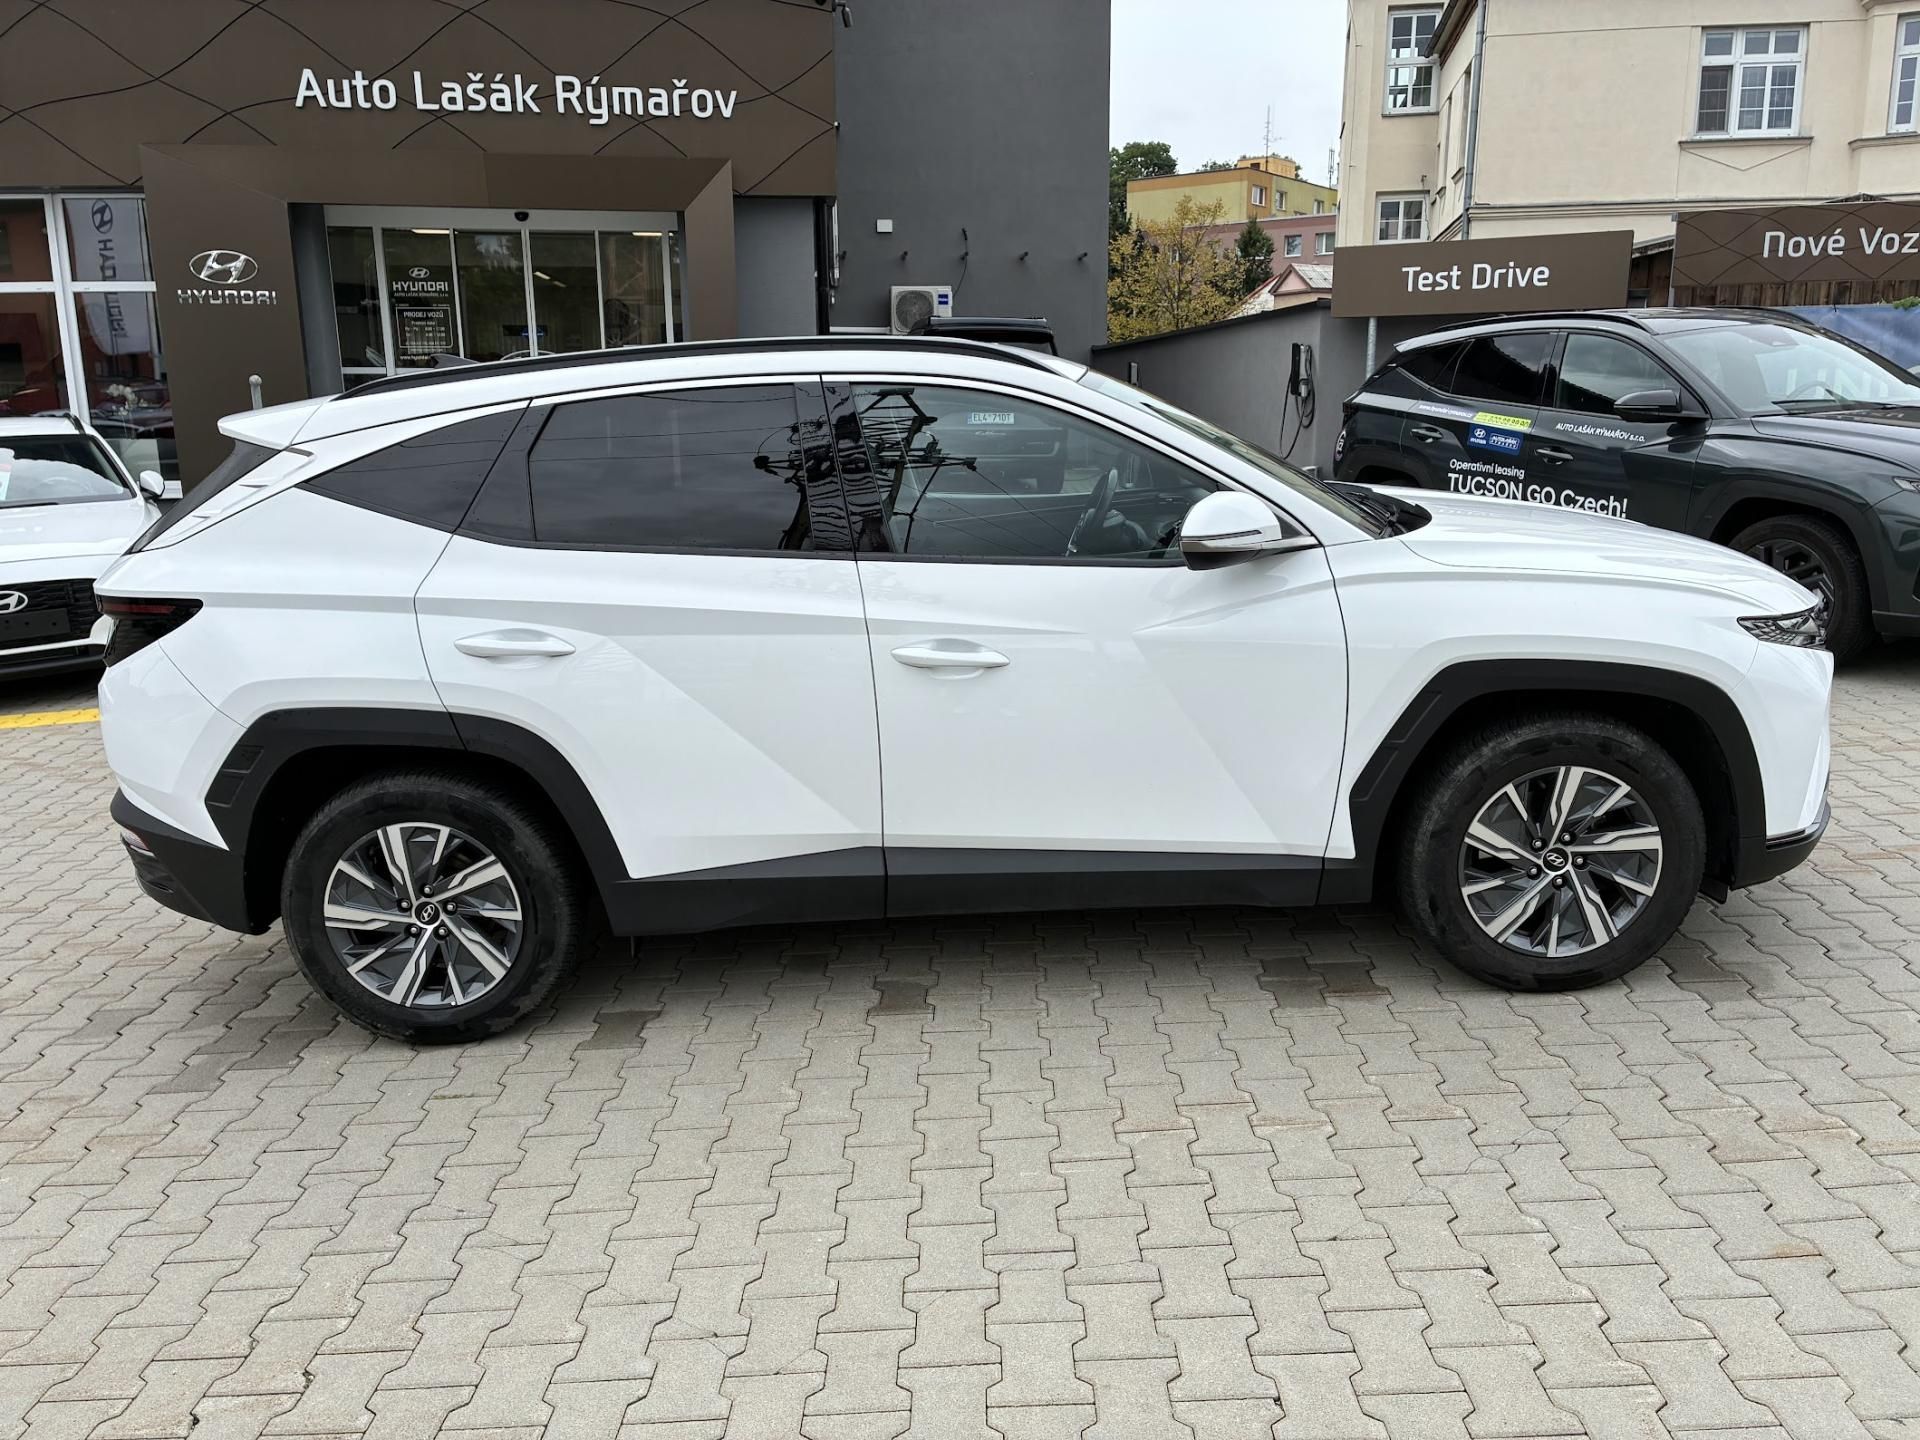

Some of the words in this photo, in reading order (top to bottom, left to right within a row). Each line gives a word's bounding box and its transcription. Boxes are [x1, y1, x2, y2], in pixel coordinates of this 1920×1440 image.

[295, 68, 397, 110] Auto
[413, 71, 541, 113] Lašák
[555, 75, 737, 125] Rýmařov
[1763, 228, 1846, 258] Nové
[393, 281, 449, 291] HYUNDAI
[1401, 265, 1462, 292] Test
[1472, 261, 1550, 290] Drive
[177, 289, 276, 304] HYUNDAI
[1555, 422, 1574, 432] AUTO
[1573, 424, 1595, 435] LAŠÁK
[1594, 426, 1631, 440] RÝMAŘOV
[1449, 458, 1494, 473] Operativní
[1495, 463, 1525, 480] leasing
[1448, 473, 1523, 501] TUCSON
[1527, 484, 1556, 505] GO
[1560, 489, 1628, 518] Czech!
